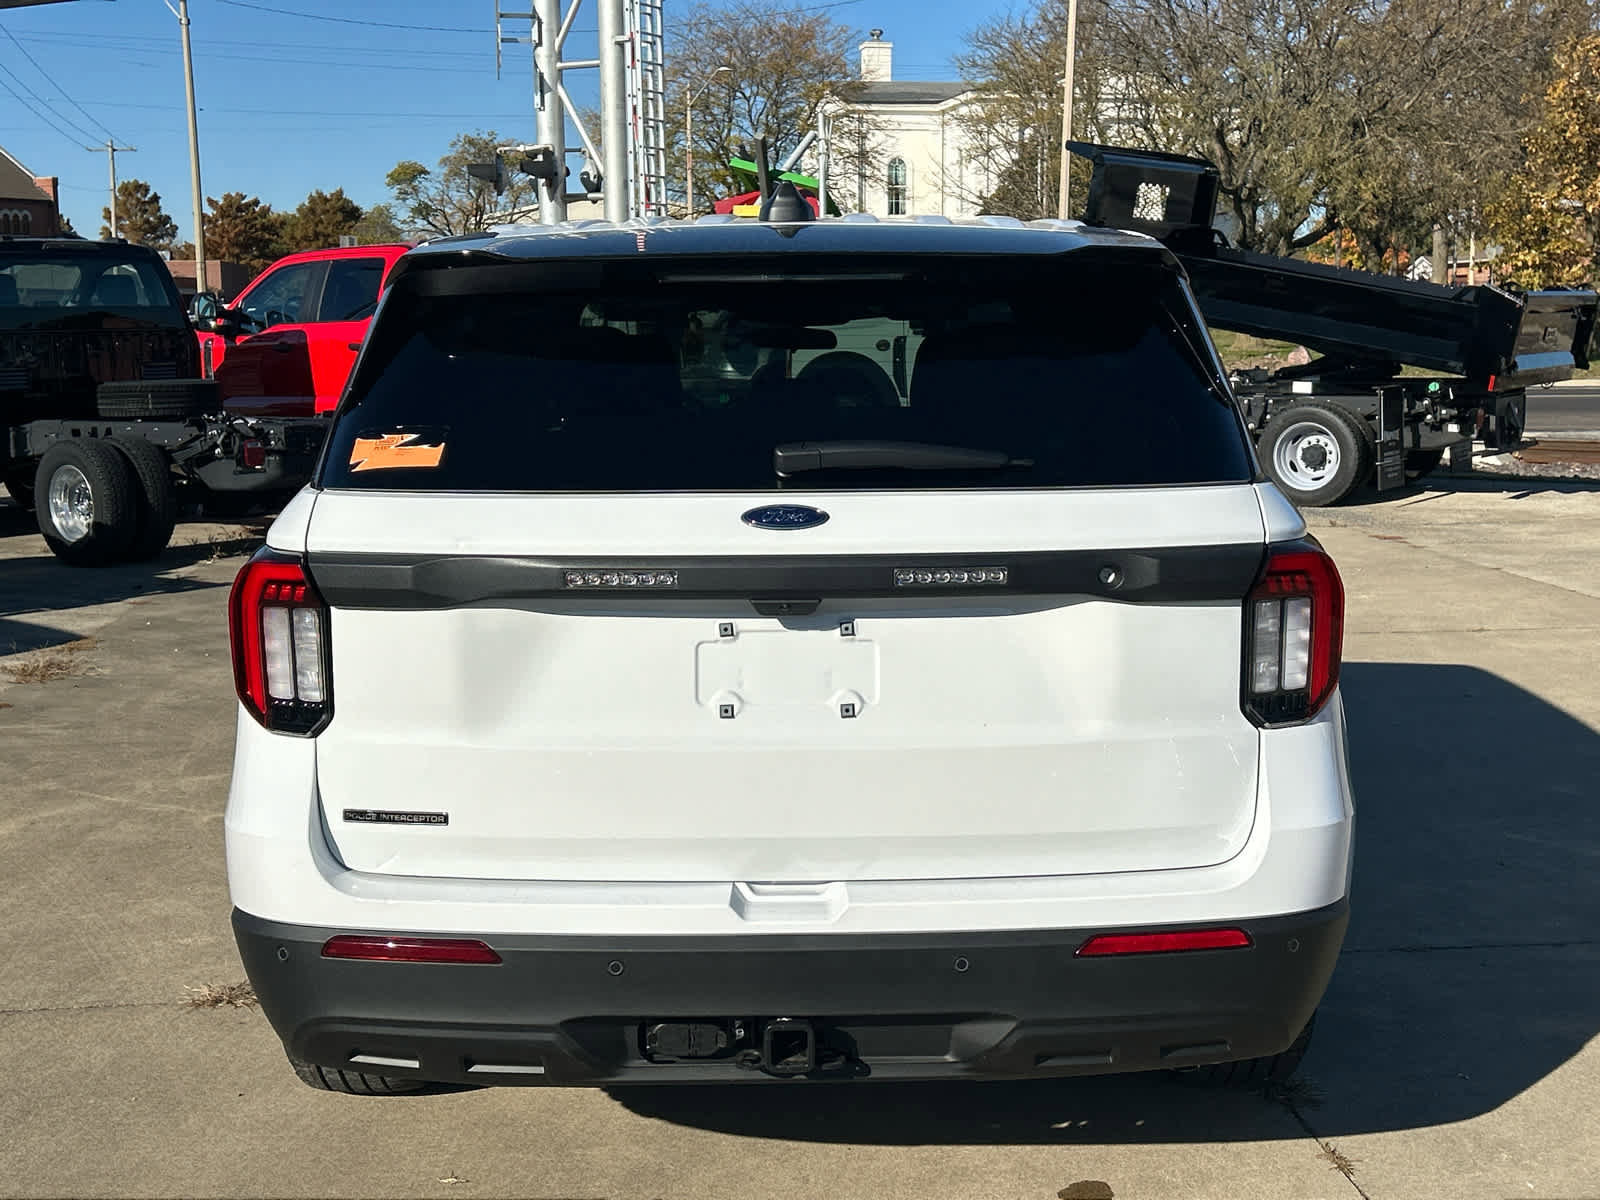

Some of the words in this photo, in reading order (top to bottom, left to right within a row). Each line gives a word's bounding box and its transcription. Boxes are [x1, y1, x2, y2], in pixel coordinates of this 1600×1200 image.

[761, 510, 809, 523] Ford
[345, 812, 377, 821] POLICE
[380, 813, 445, 823] INTERCEPTOR
